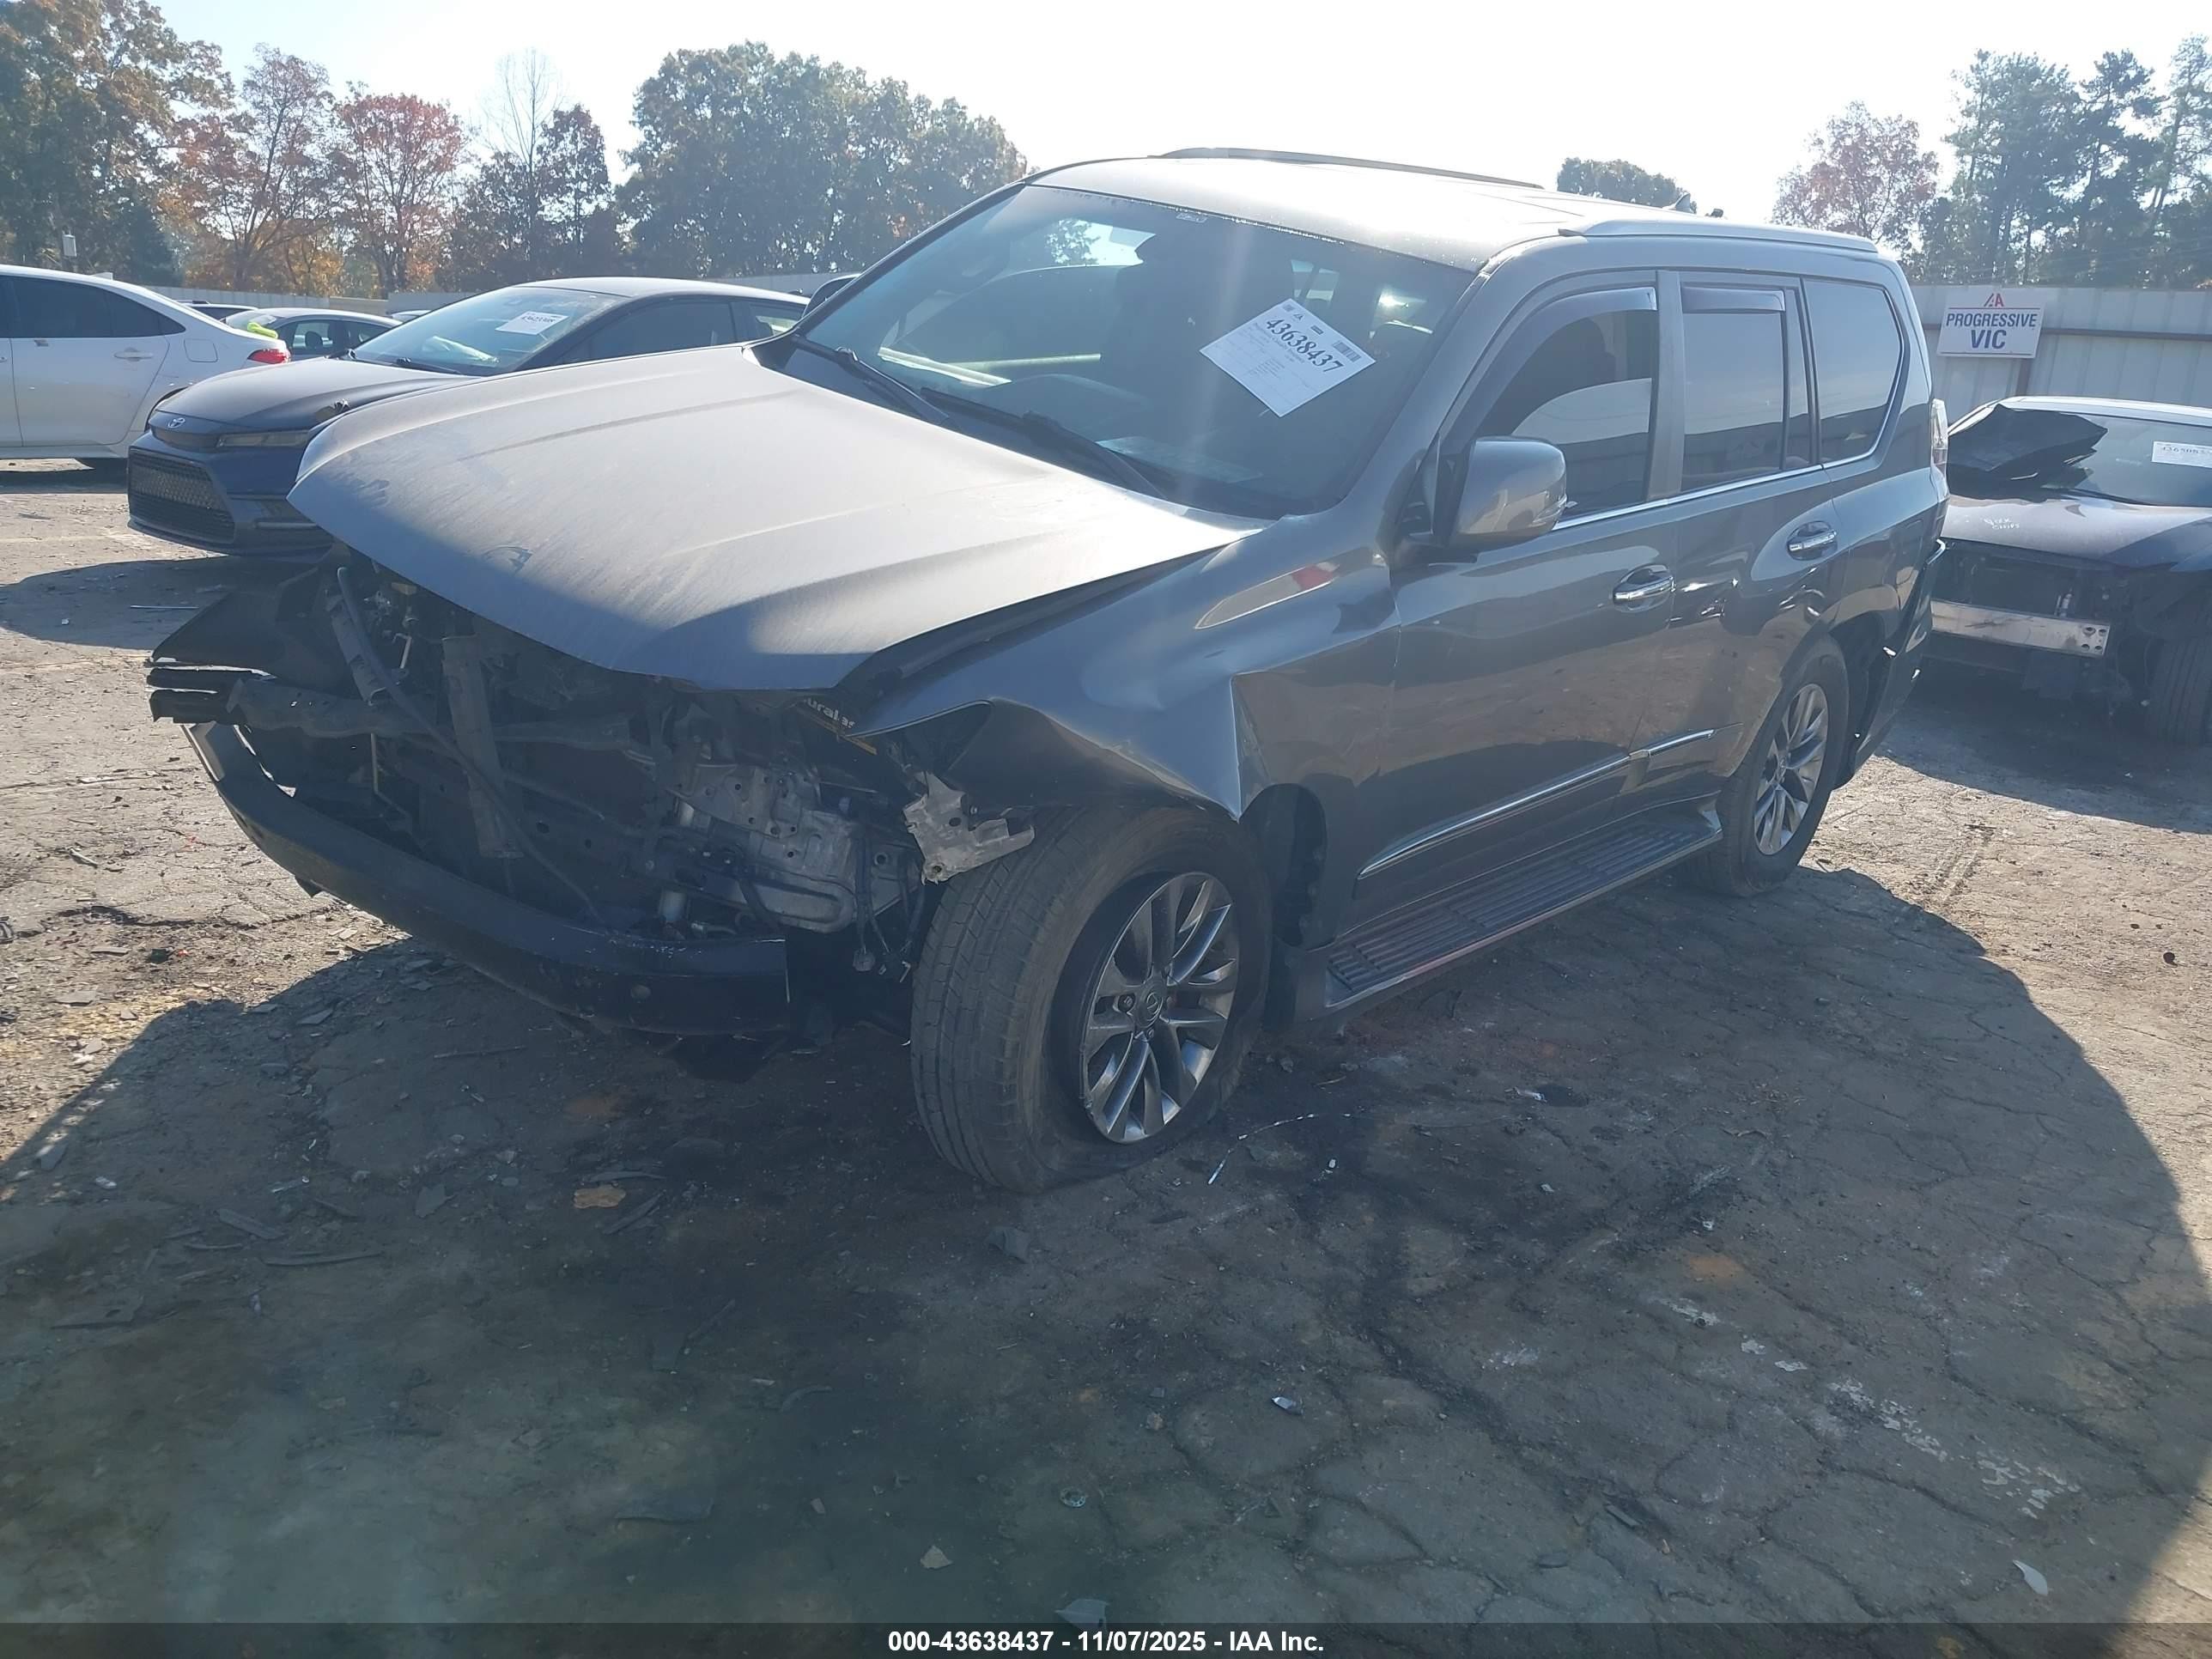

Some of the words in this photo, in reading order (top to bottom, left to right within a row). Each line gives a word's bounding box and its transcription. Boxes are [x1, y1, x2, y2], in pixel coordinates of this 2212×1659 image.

[1946, 313, 2038, 327] PROGRESSIVE
[1266, 319, 1344, 373] 43638437
[1971, 329, 2007, 349] VIC
